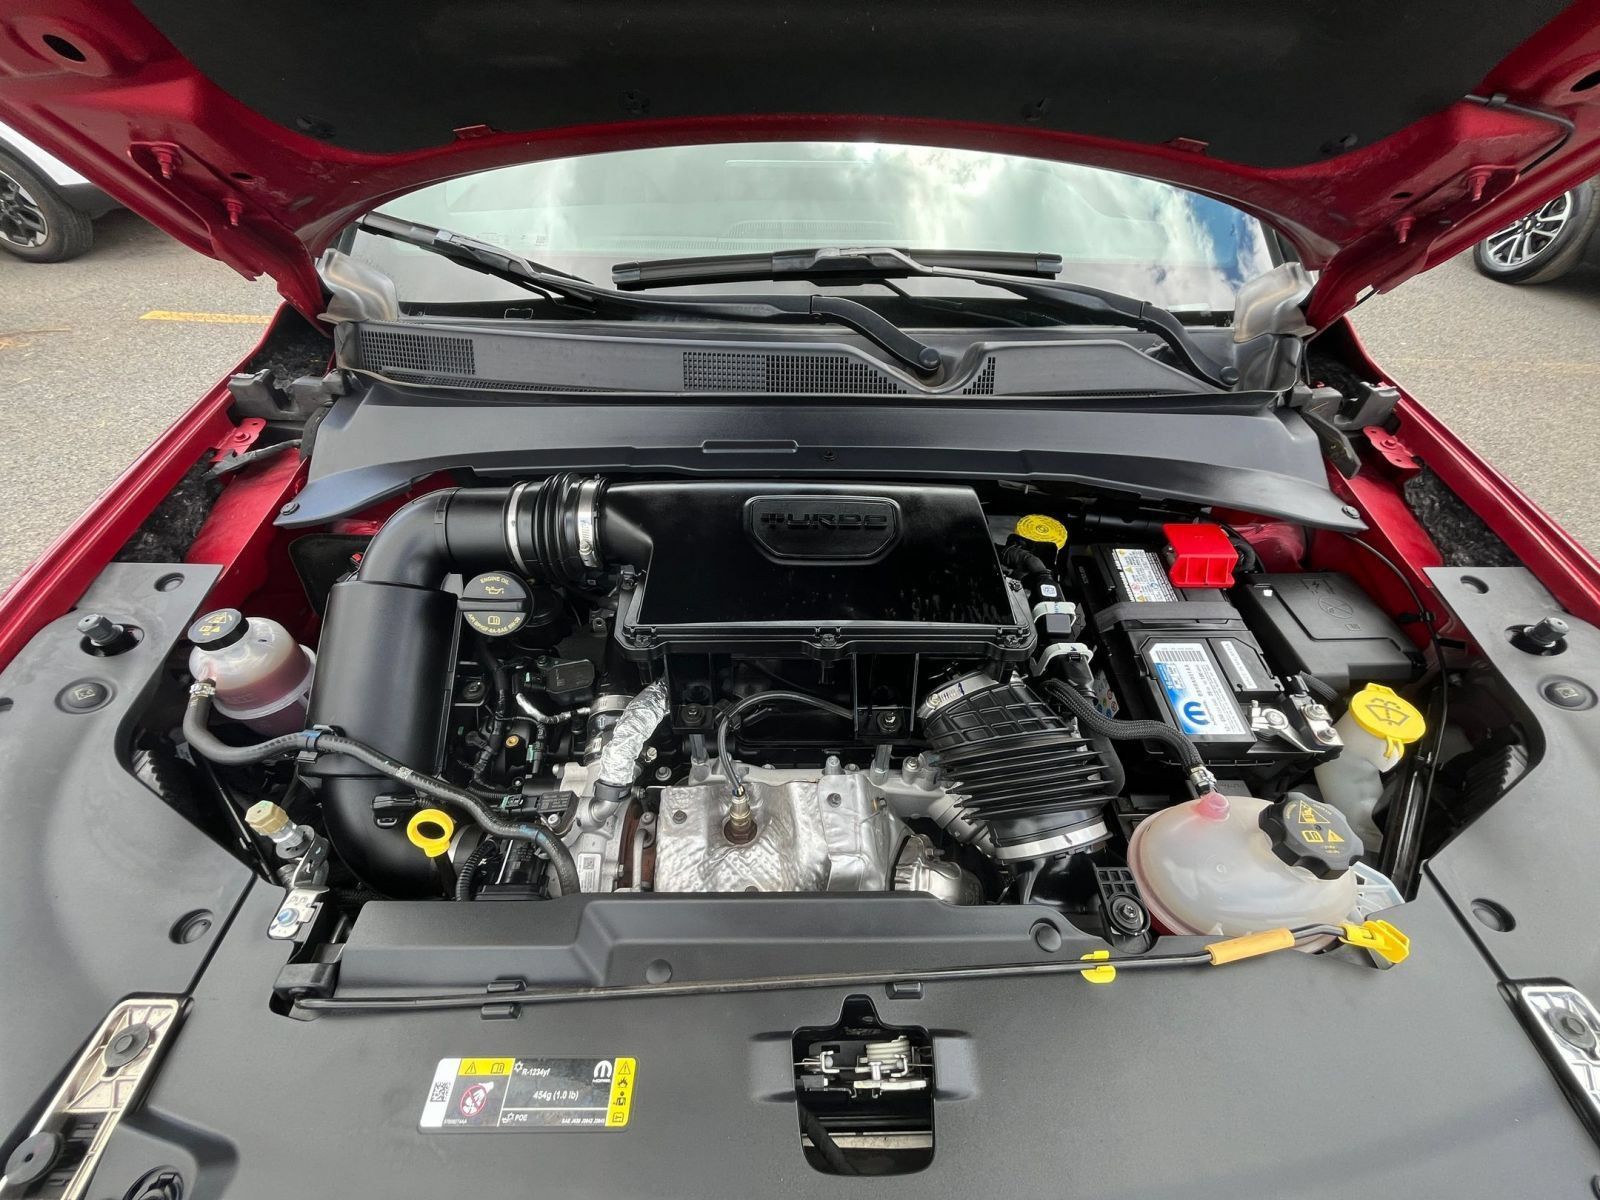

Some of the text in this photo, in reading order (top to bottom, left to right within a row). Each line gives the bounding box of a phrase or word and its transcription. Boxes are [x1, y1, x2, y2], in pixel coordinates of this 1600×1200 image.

[760, 511, 888, 530] TURBO
[501, 577, 510, 585] OIL
[521, 1068, 551, 1077] R-1234yf
[533, 1091, 552, 1101] 454g
